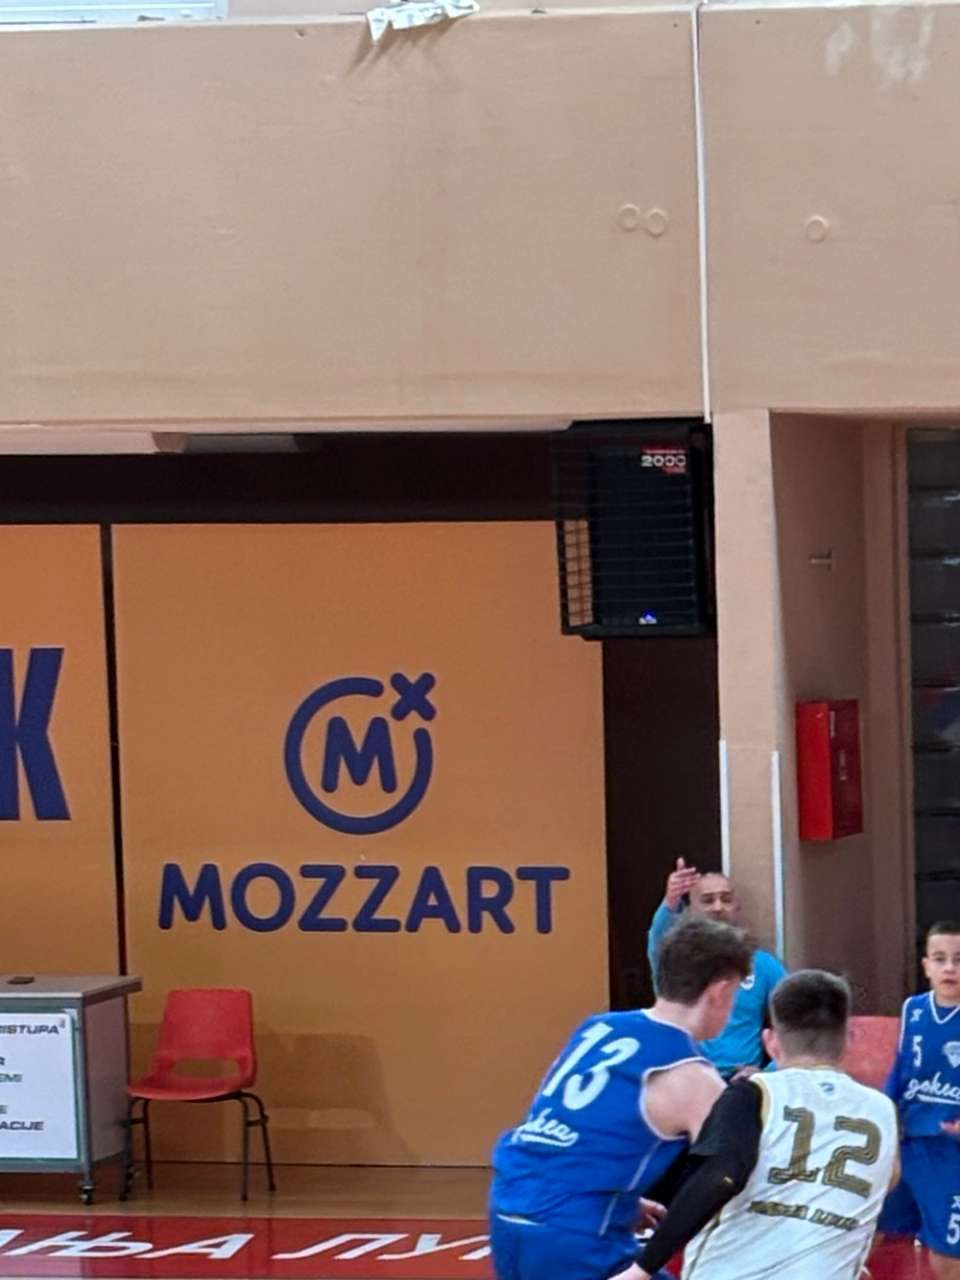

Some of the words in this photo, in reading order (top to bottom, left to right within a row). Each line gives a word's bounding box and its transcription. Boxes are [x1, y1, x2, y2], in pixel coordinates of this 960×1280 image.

[640, 454, 688, 468] 2000
[158, 863, 571, 935] MOZZART
[541, 1021, 640, 1111] 13
[912, 1034, 923, 1068] 5
[767, 1104, 882, 1200] 12
